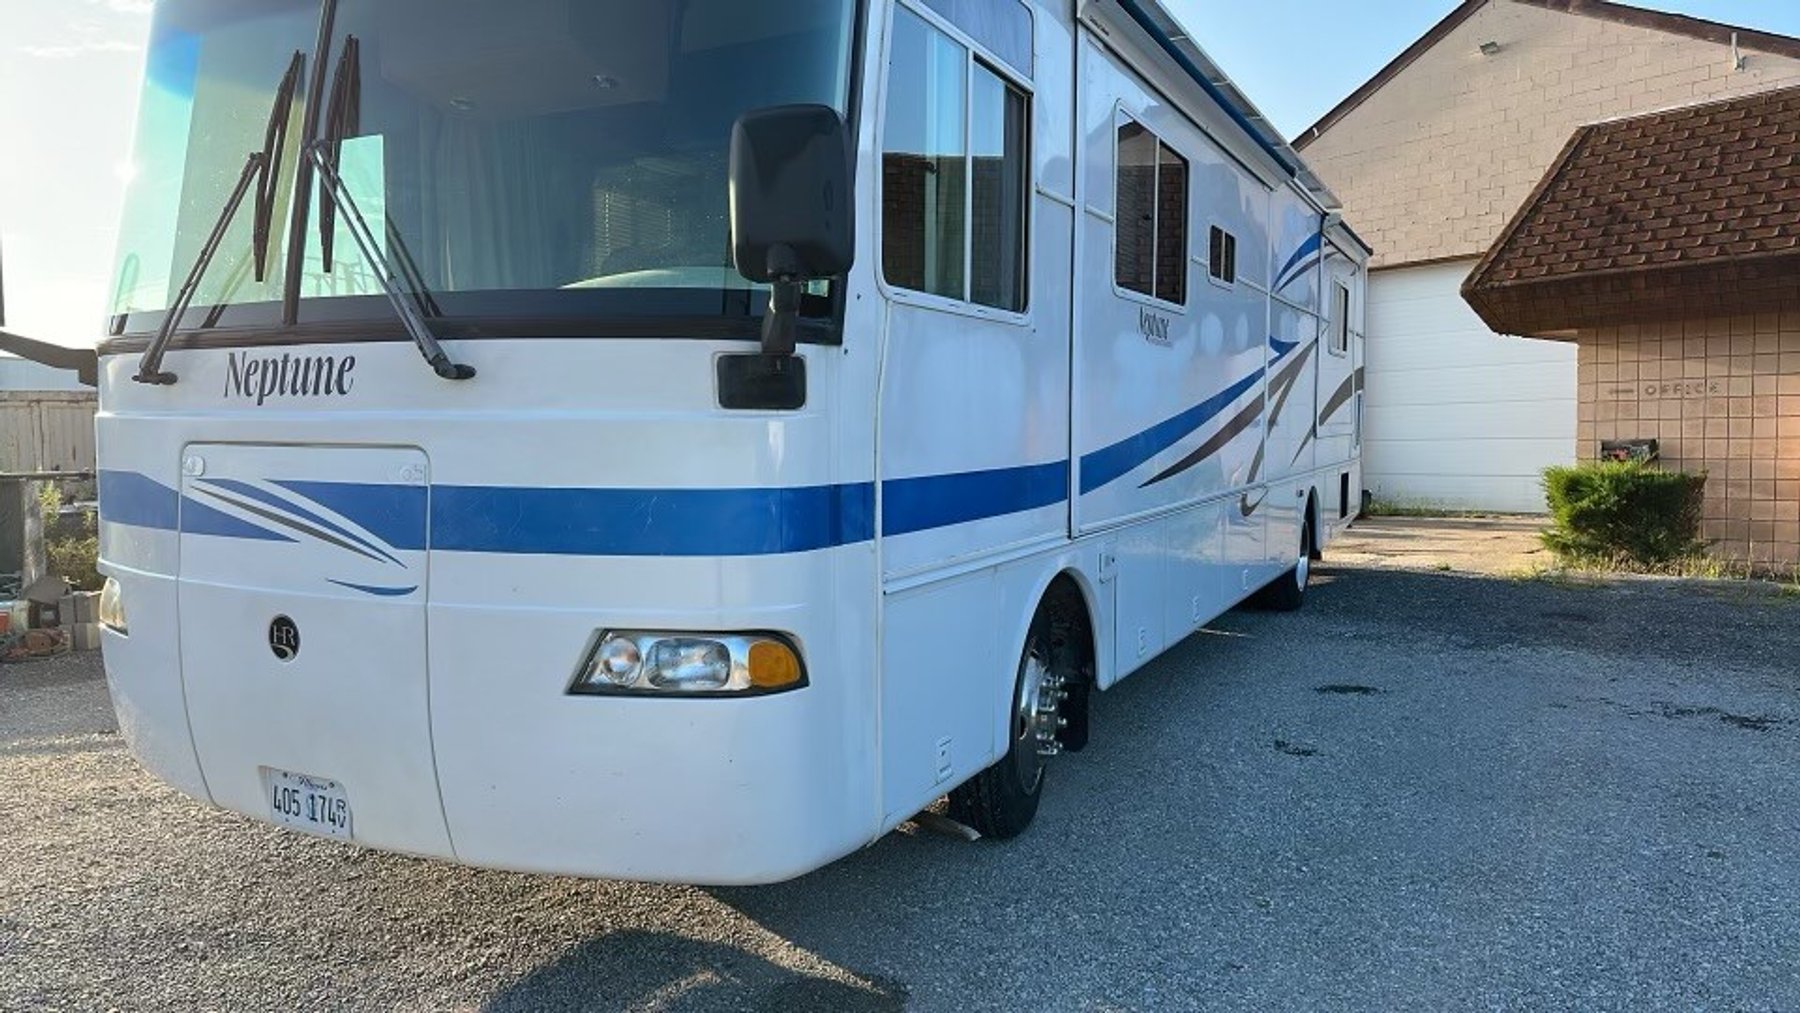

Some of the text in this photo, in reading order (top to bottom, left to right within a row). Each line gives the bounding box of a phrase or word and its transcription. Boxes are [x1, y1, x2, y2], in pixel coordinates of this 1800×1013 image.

[224, 351, 356, 406] Neptune
[1644, 382, 1720, 396] OFFICE
[273, 784, 336, 826] 405 174
